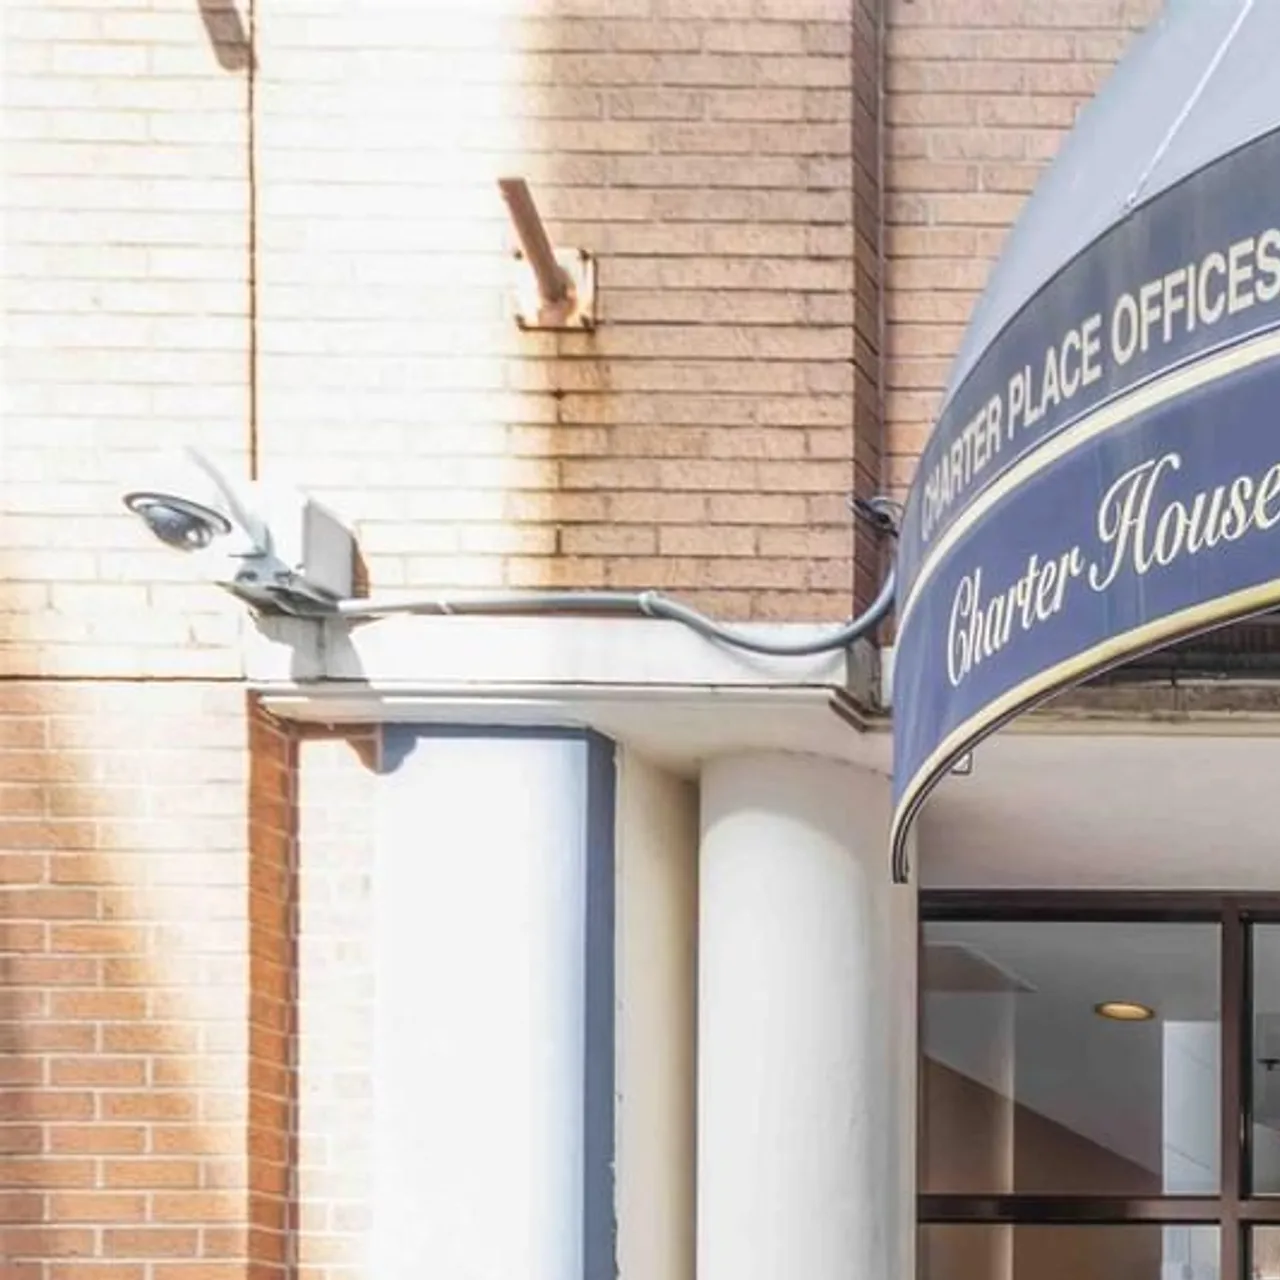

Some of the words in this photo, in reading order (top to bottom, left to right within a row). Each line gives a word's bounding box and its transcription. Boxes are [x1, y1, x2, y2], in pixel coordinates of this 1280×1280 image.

[922, 394, 1002, 541] CHARTER
[1008, 312, 1101, 439] PLACE
[947, 544, 1084, 687] Charter
